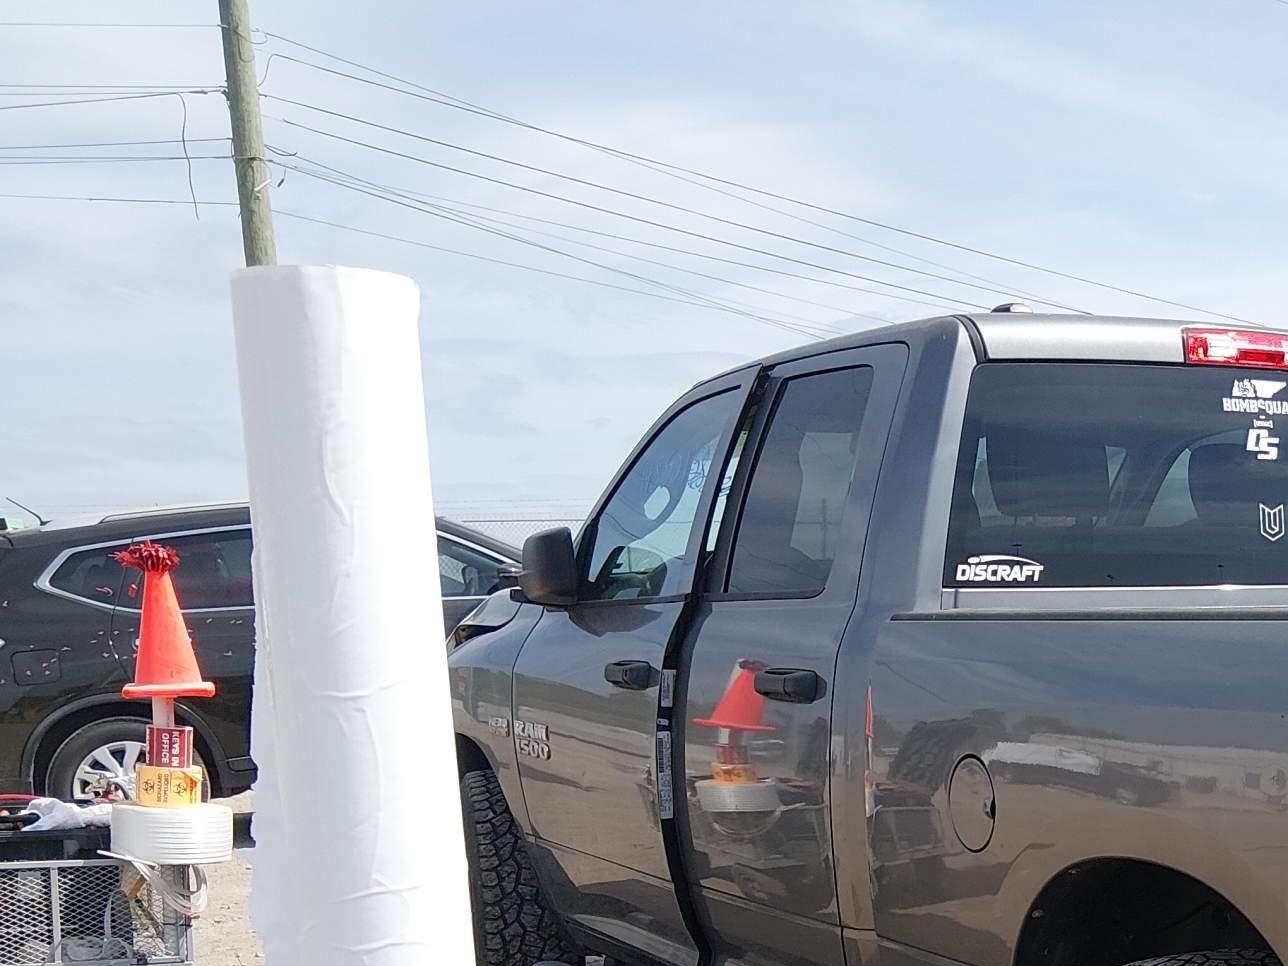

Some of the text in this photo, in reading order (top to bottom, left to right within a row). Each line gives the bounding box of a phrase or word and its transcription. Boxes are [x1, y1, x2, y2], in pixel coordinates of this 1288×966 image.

[956, 564, 1044, 582] DISCRAFT
[513, 720, 549, 741] RAM
[161, 732, 170, 764] OFFICE
[171, 731, 180, 767] KEYS IN
[515, 738, 551, 760] 1500
